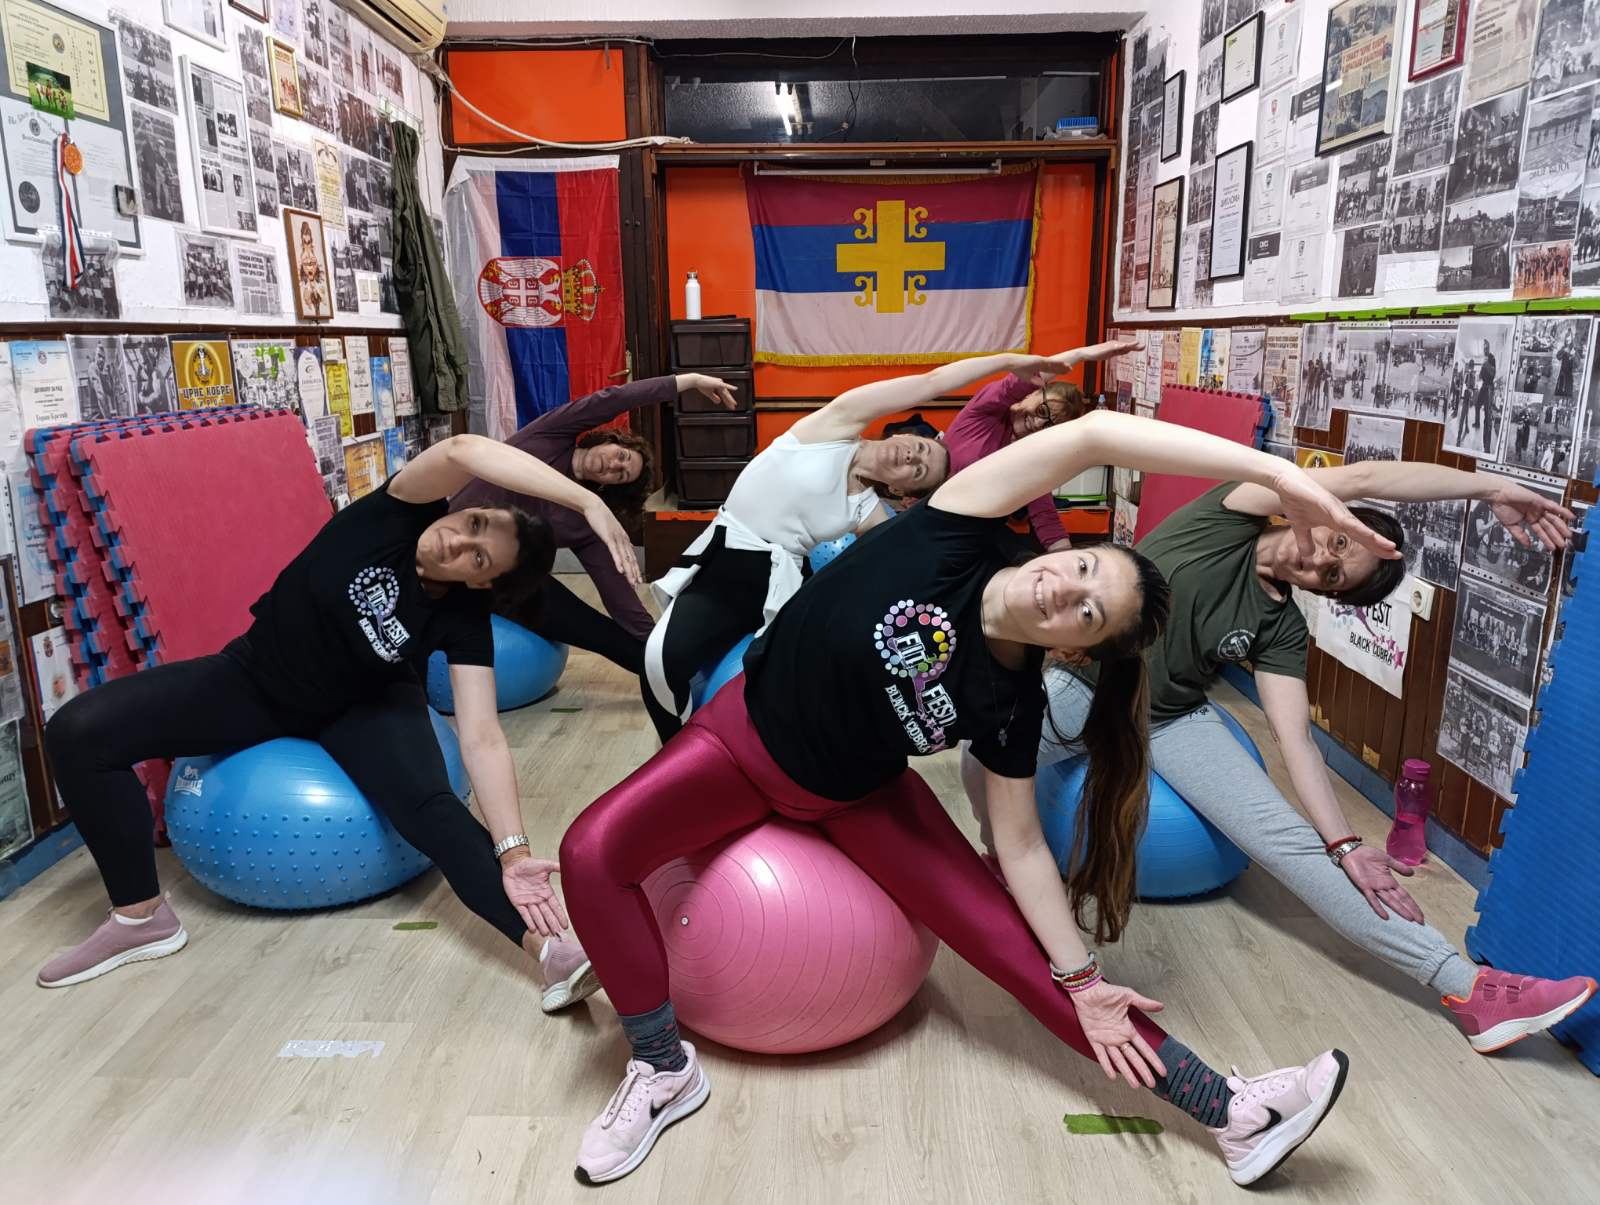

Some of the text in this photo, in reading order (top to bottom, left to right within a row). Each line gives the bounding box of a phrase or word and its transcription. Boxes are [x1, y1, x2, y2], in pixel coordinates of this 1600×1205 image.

[1349, 631, 1393, 665] BLACK COBRA
[921, 683, 957, 727] FEST
